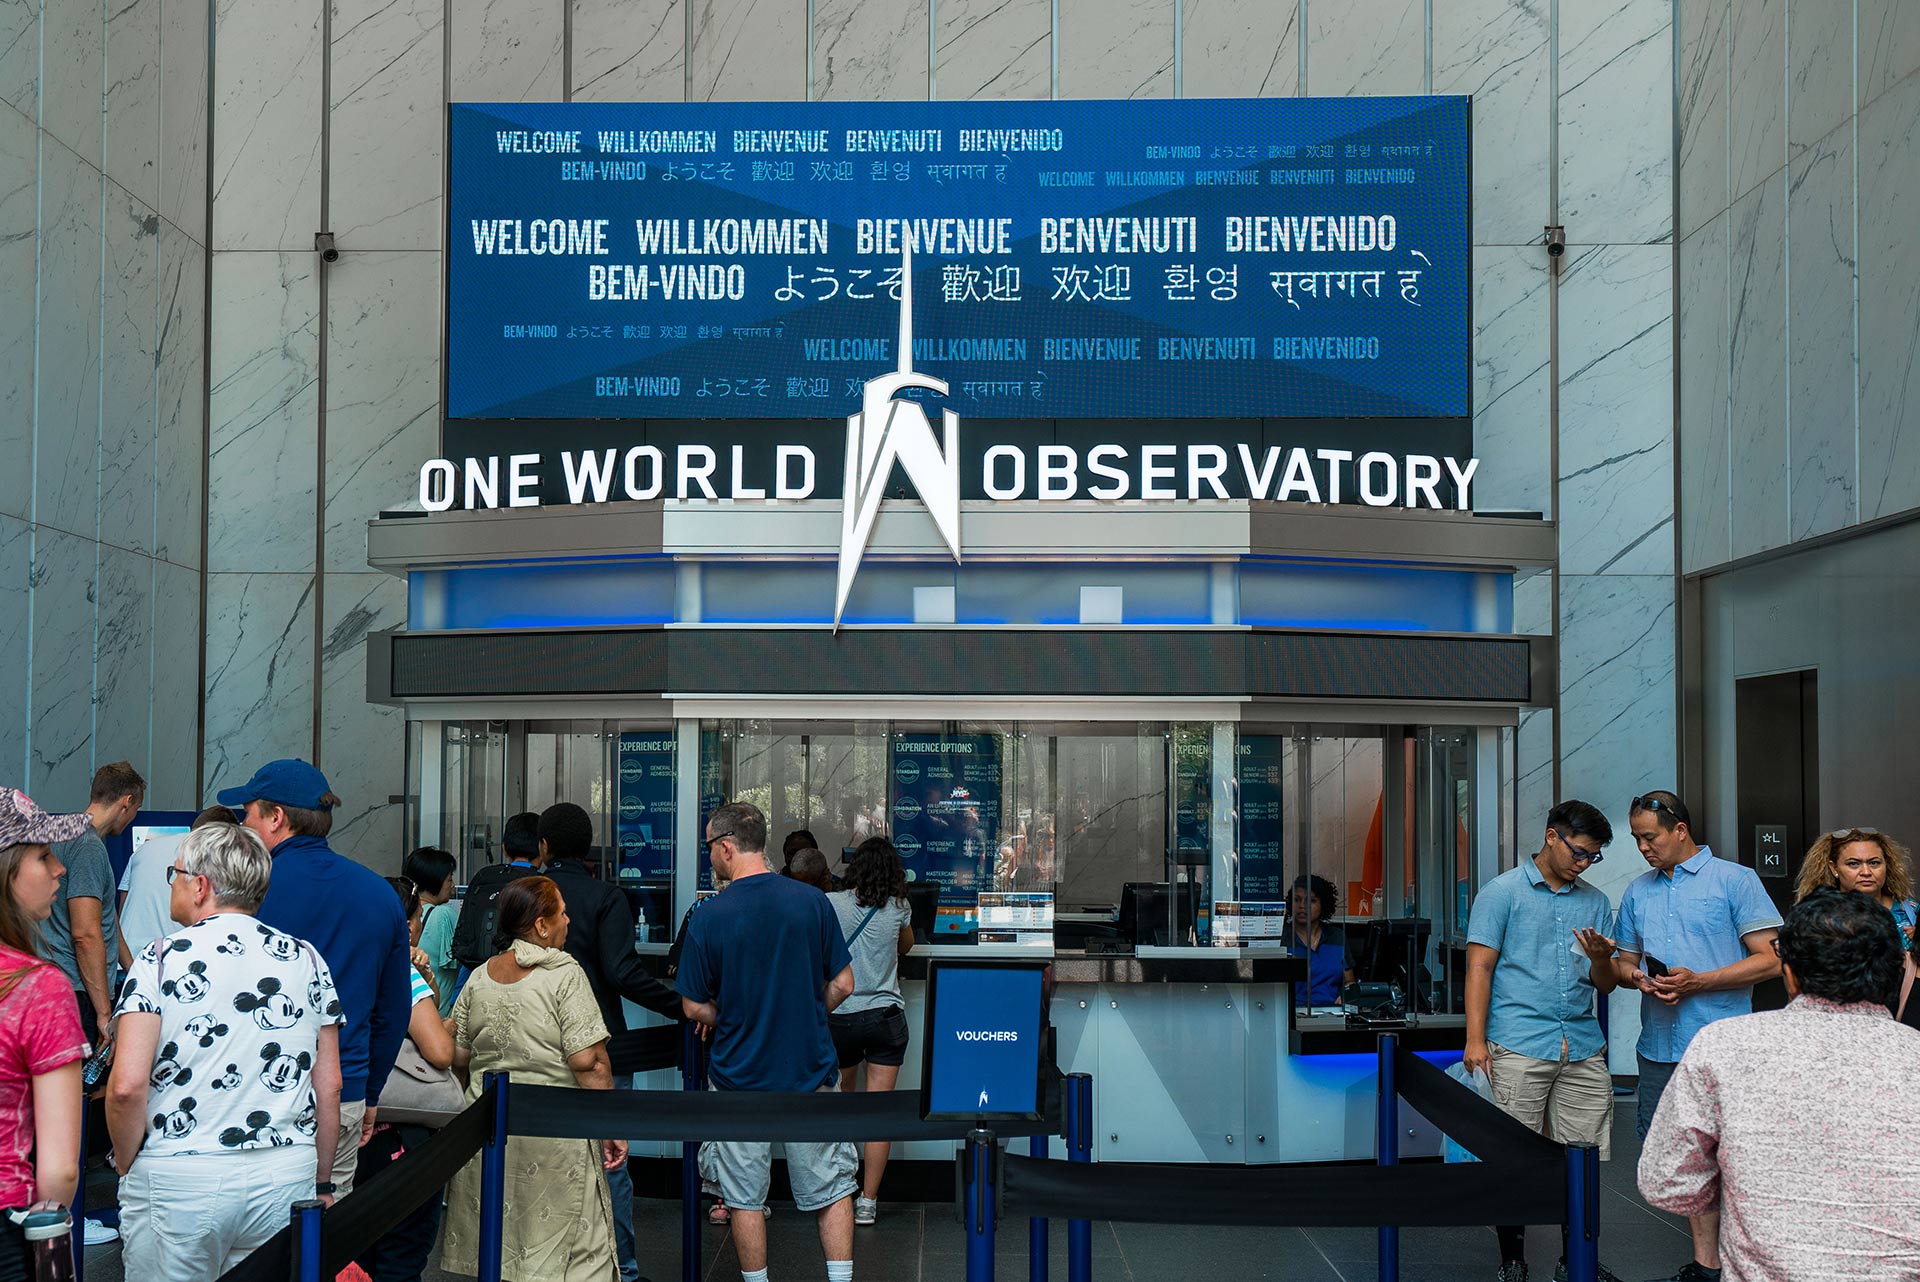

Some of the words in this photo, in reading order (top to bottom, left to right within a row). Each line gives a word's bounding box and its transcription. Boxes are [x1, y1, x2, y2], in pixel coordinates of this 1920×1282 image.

[496, 130, 582, 153] WELCOME
[598, 130, 716, 153] WILLKOMMEN
[733, 130, 829, 152] BIENVENUE
[846, 129, 942, 152] BENVENUTI
[959, 128, 1063, 152] BIENVENIDO
[1146, 145, 1200, 159] BEM-VINDO
[1210, 146, 1258, 159] ようこそ
[562, 160, 646, 181] BEM-VINDO
[662, 162, 736, 182] ようこそ
[751, 160, 795, 182] 歡迎
[810, 160, 854, 182] 欢迎
[870, 160, 911, 182] 환영
[1038, 172, 1096, 187] WELCOME
[1106, 170, 1185, 187] WILLKOMMEN
[1195, 170, 1259, 186] BIENVENUE
[1270, 169, 1335, 185] BENVENUTI
[1345, 168, 1415, 185] BIENVENIDO
[471, 218, 609, 256] WELCOME
[636, 218, 828, 255] WILLKOMMEN
[856, 218, 1012, 255] BIENVENUE
[1040, 216, 1197, 254] BENVENUTI
[1226, 215, 1397, 252] BIENVENIDO
[589, 264, 745, 301] BEM-VINDO
[774, 266, 904, 301] ようこそ
[942, 264, 1022, 303] 歡迎
[1050, 264, 1132, 303] 欢迎
[1163, 264, 1238, 300] 환영
[504, 324, 557, 338] BEM-VINDO
[566, 325, 614, 339] ようこそ
[804, 338, 890, 361] WELCOME
[1044, 338, 1141, 361] BIENVENUE
[1158, 337, 1256, 361] BENVENUTI
[1273, 336, 1380, 360] BIENVENIDO
[596, 376, 681, 397] BEM-VINDO
[696, 378, 771, 398] ようこそ
[786, 378, 830, 399] 歡迎
[420, 454, 541, 512] ONE
[561, 444, 815, 504] WORLD
[983, 443, 1480, 511] OBSERVATORY
[619, 741, 661, 752] EXPERIENCE
[896, 742, 940, 753] EXPERIENCE
[941, 743, 972, 754] OPTIONS
[1765, 854, 1779, 865] K1
[956, 1031, 1018, 1042] VOUCHERS
